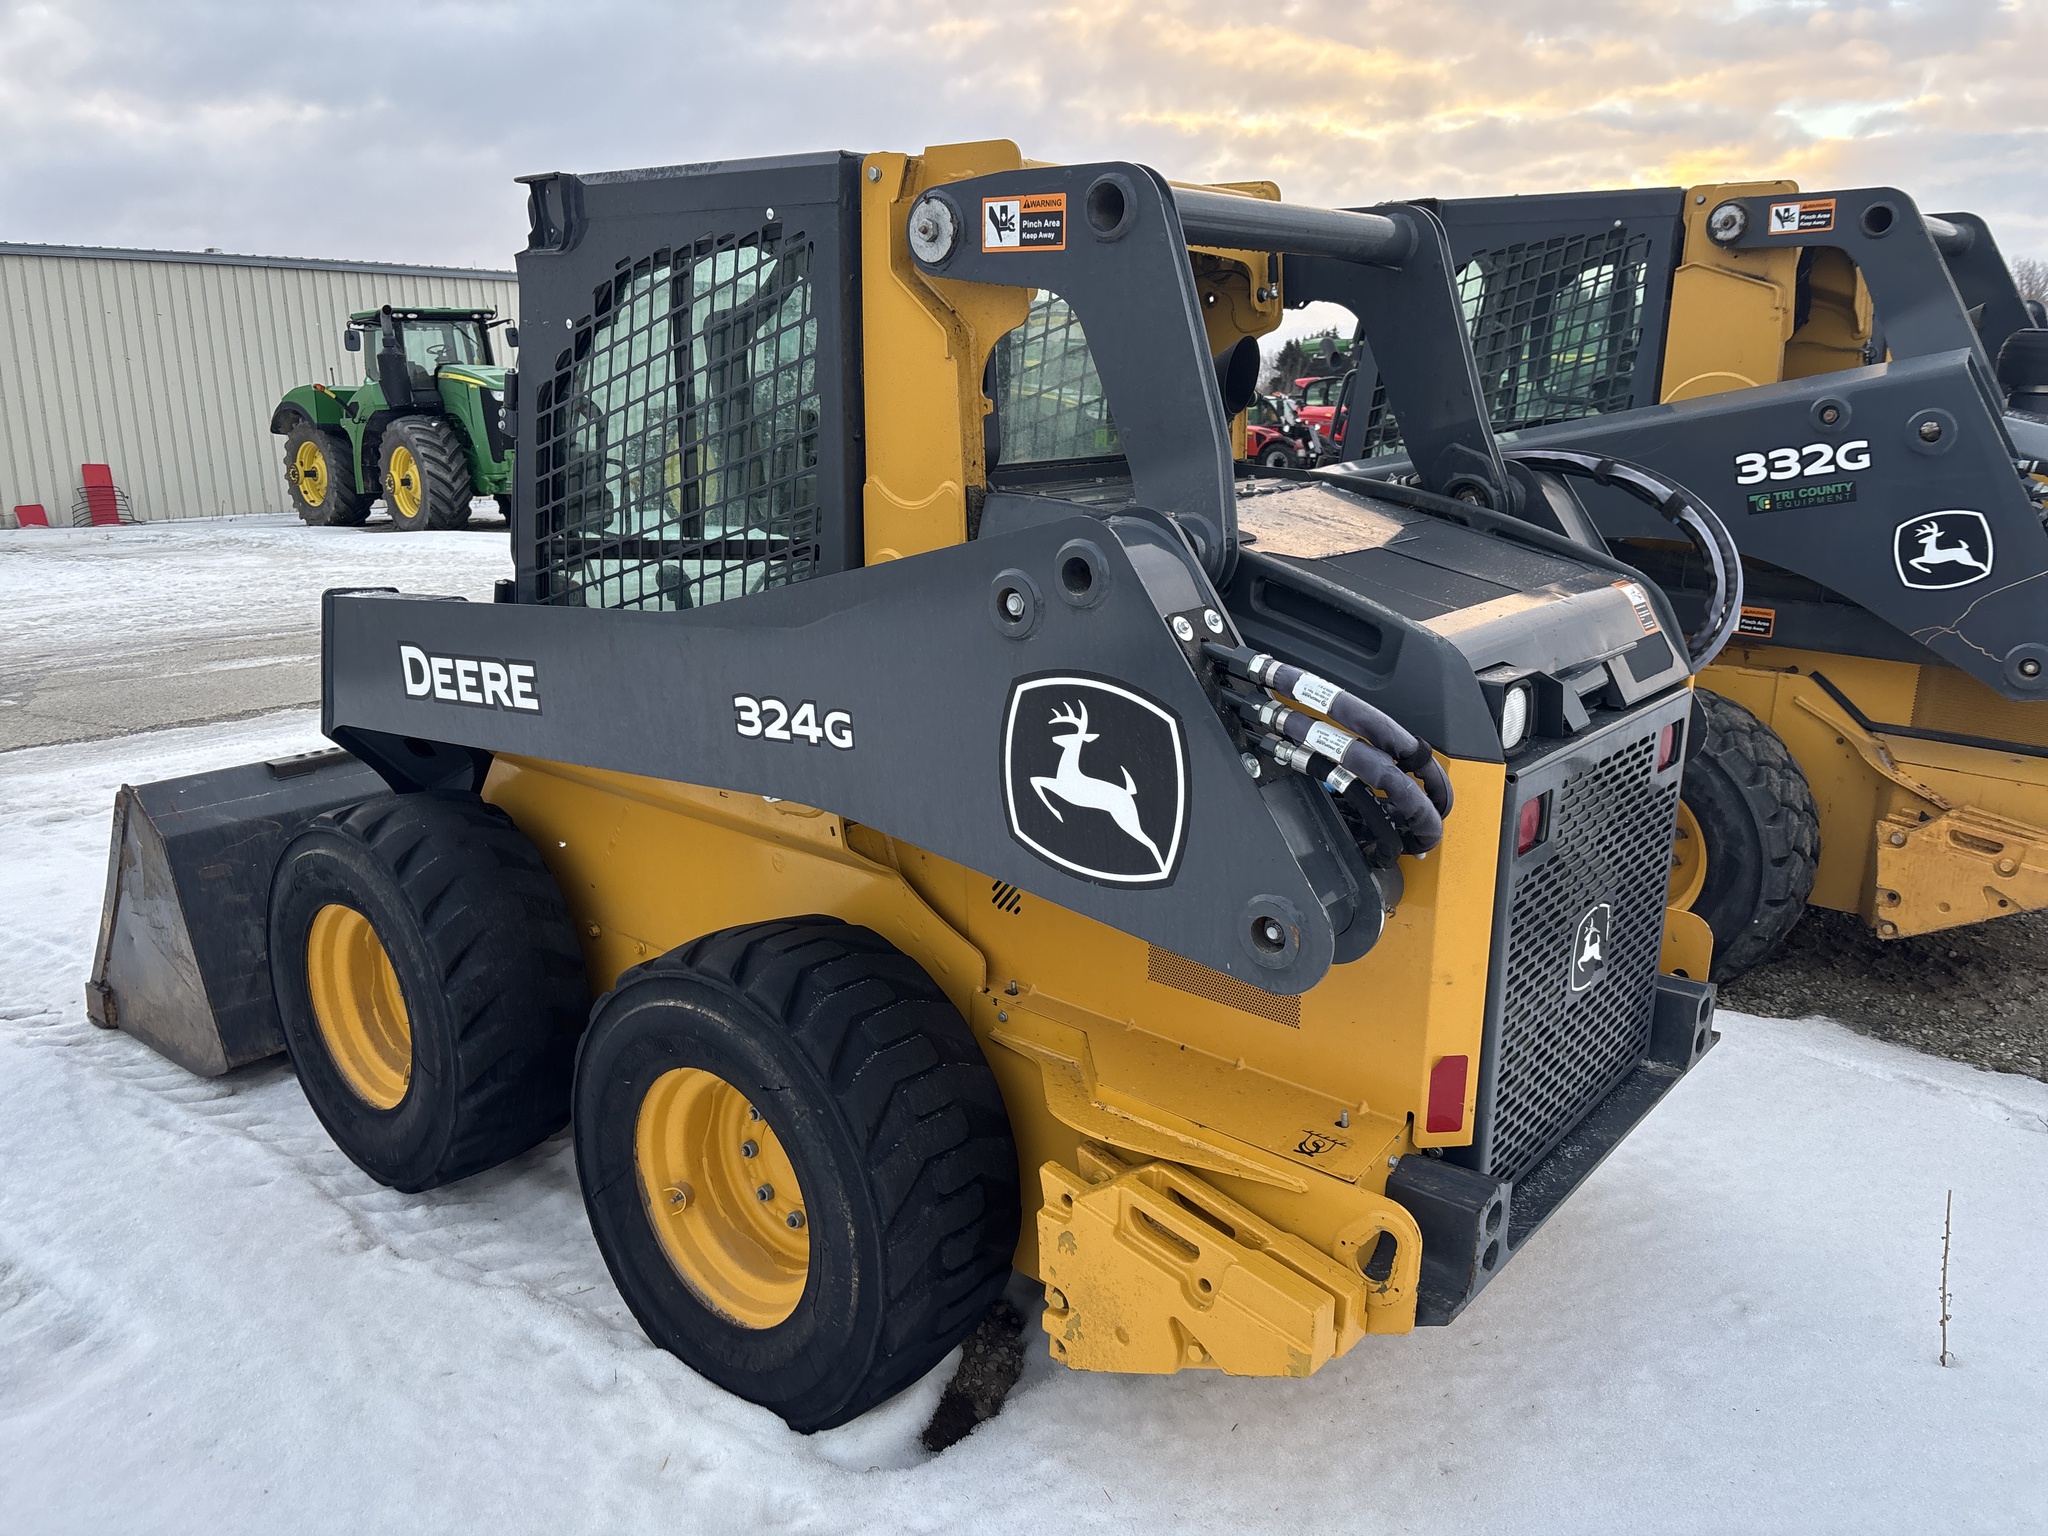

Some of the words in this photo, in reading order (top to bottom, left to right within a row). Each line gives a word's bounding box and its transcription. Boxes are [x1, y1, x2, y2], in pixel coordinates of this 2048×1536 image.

[1029, 198, 1062, 208] WARNING
[1022, 219, 1042, 229] Pinch
[1043, 218, 1061, 228] Area
[1022, 232, 1038, 240] Keep
[1038, 231, 1055, 240] Away
[1735, 440, 1871, 485] 332G
[1773, 489, 1795, 501] TRI
[1798, 481, 1853, 498] COUNTY
[1776, 492, 1851, 509] EQUIPMENT
[400, 645, 540, 710] DEERE
[734, 696, 853, 749] 324G
